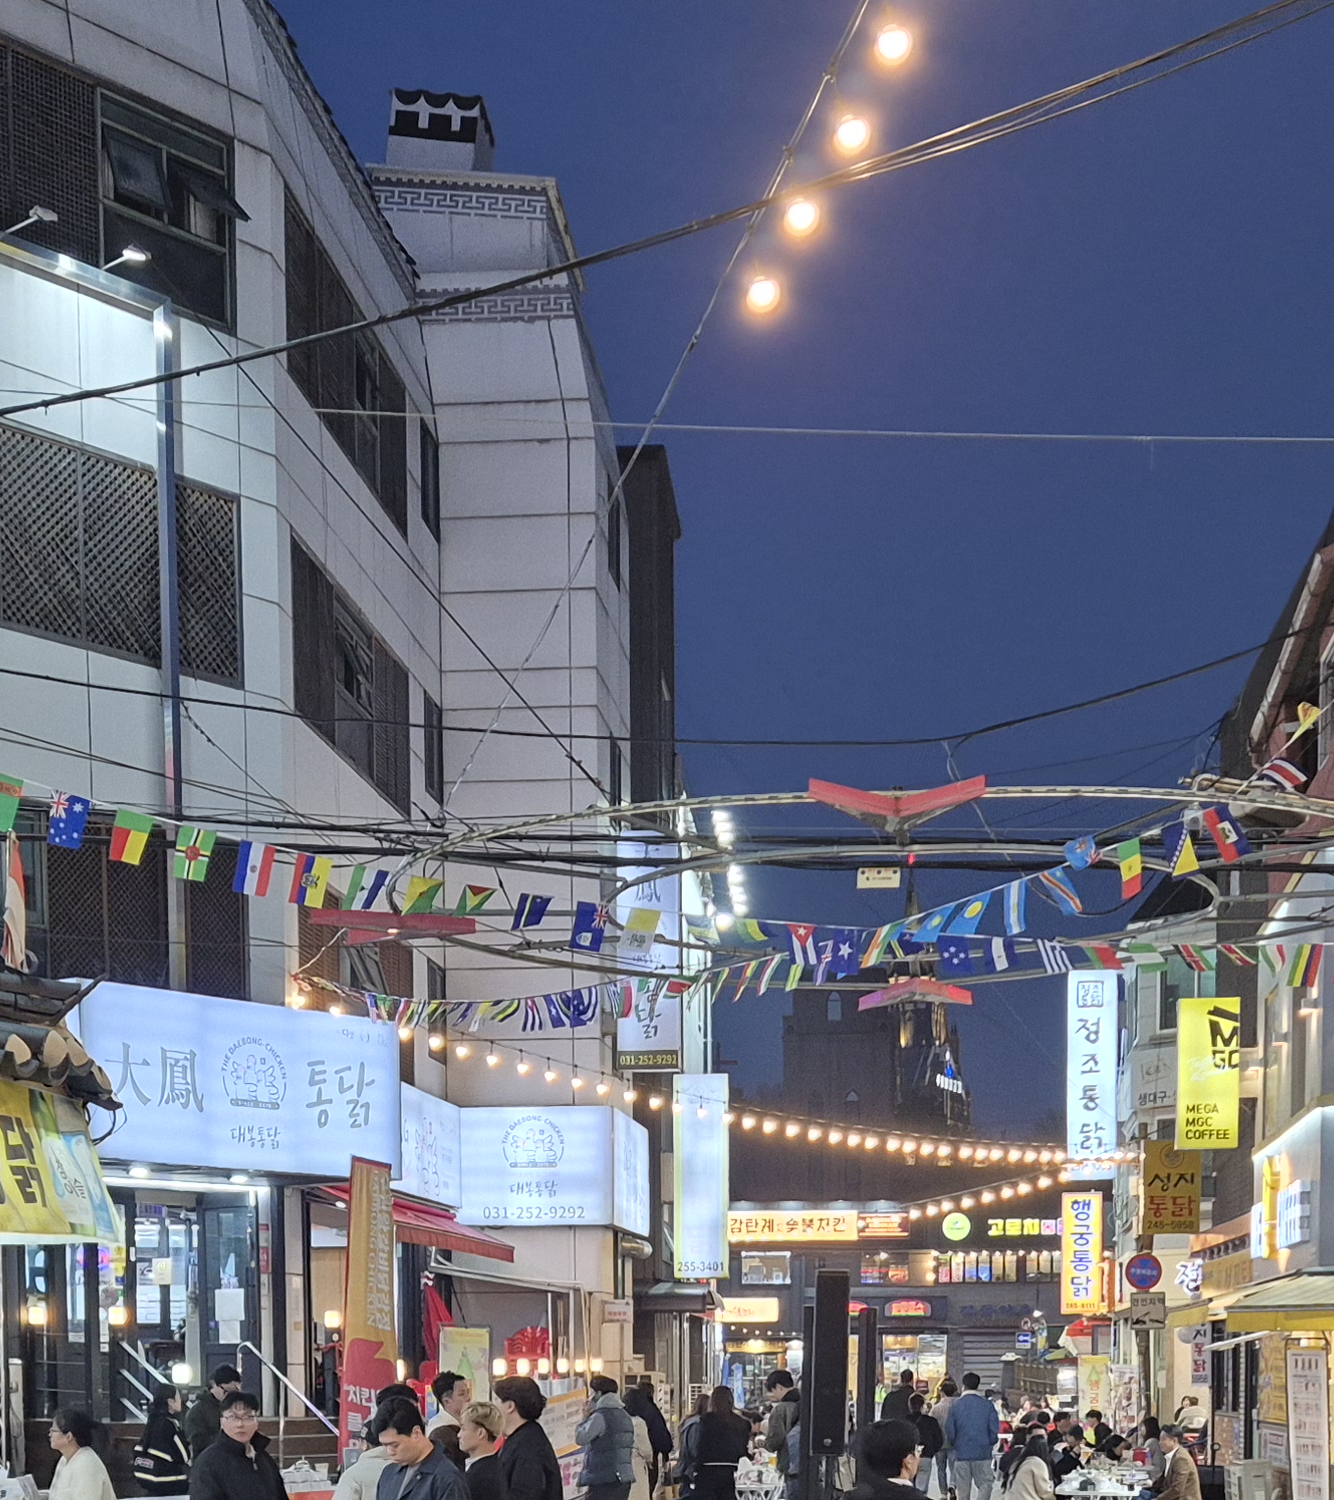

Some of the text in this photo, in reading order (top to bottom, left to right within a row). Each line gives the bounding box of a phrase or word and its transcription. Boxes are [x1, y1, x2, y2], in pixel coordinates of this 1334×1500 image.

[220, 1036, 288, 1080] THE DAEBONG CHICKEN
[619, 1053, 677, 1066] 031-252-9292
[1075, 1017, 1106, 1149] 정조통닭
[306, 1060, 375, 1129] 통닭
[1186, 1103, 1219, 1114] MEGA
[509, 1115, 542, 1132] DAEBONG
[543, 1118, 565, 1145] CHICKEN
[1186, 1117, 1213, 1127] MGC
[230, 1125, 281, 1150] 대봉통닭
[1186, 1129, 1230, 1140] COFFEE
[509, 1180, 558, 1198] 대봉통닭
[1148, 1173, 1195, 1192] 성지
[483, 1206, 585, 1220] 031-252-9292
[1147, 1195, 1195, 1218] 통닭
[730, 1218, 774, 1233] 감탄계
[786, 1217, 846, 1233] 숯불치킨
[1070, 1199, 1093, 1297] 행궁통닭
[677, 1261, 724, 1272] 255-3401
